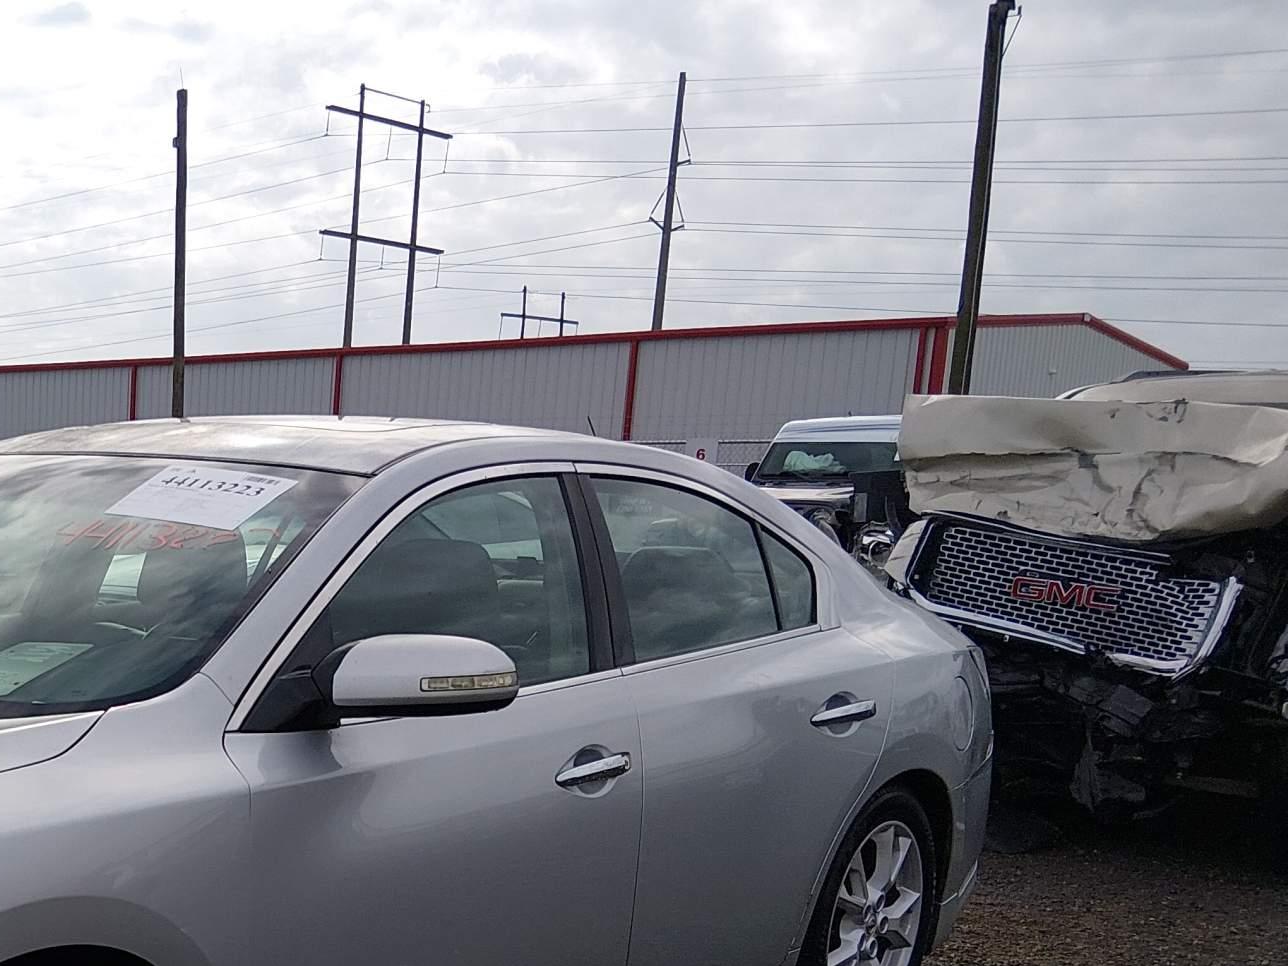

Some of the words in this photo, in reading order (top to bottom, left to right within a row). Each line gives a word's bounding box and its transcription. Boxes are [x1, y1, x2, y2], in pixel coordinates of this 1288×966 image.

[695, 448, 706, 461] 6
[161, 475, 266, 496] 44113223
[1011, 576, 1122, 611] GMC
